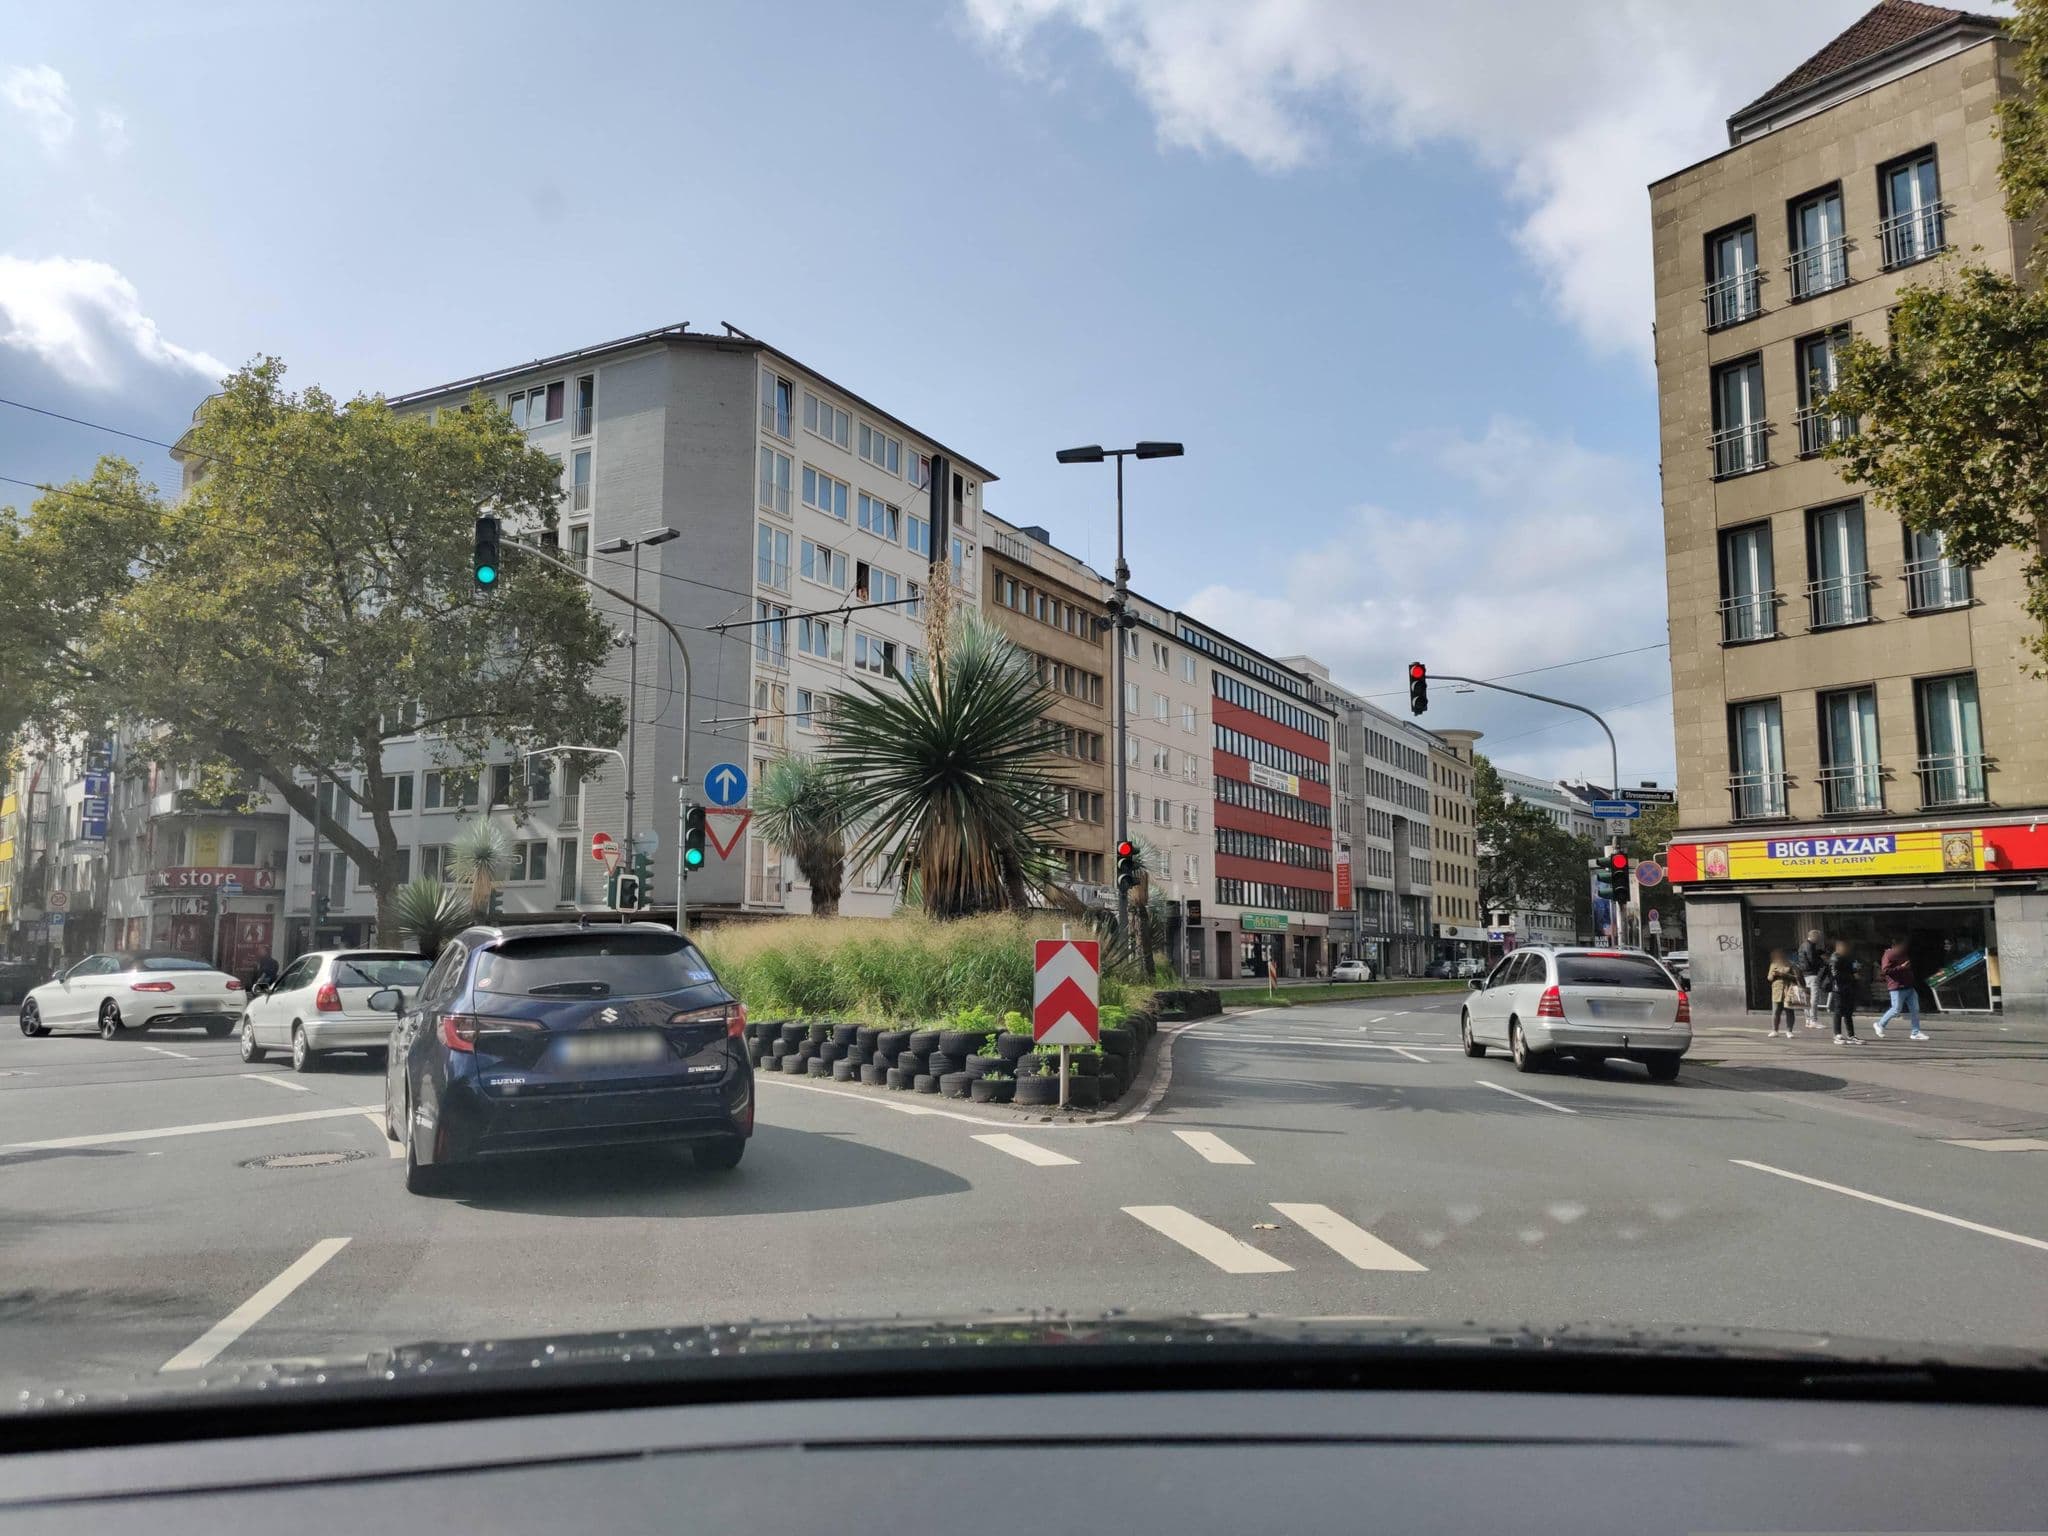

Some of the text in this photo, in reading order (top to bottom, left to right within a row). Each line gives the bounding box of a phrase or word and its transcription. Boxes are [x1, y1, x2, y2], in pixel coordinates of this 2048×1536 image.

[1775, 837, 1890, 858] BIG BAZAR
[1782, 856, 1876, 866] CASH & CARRY
[180, 869, 236, 886] store
[53, 914, 62, 924] P
[688, 1064, 721, 1073] SWACE
